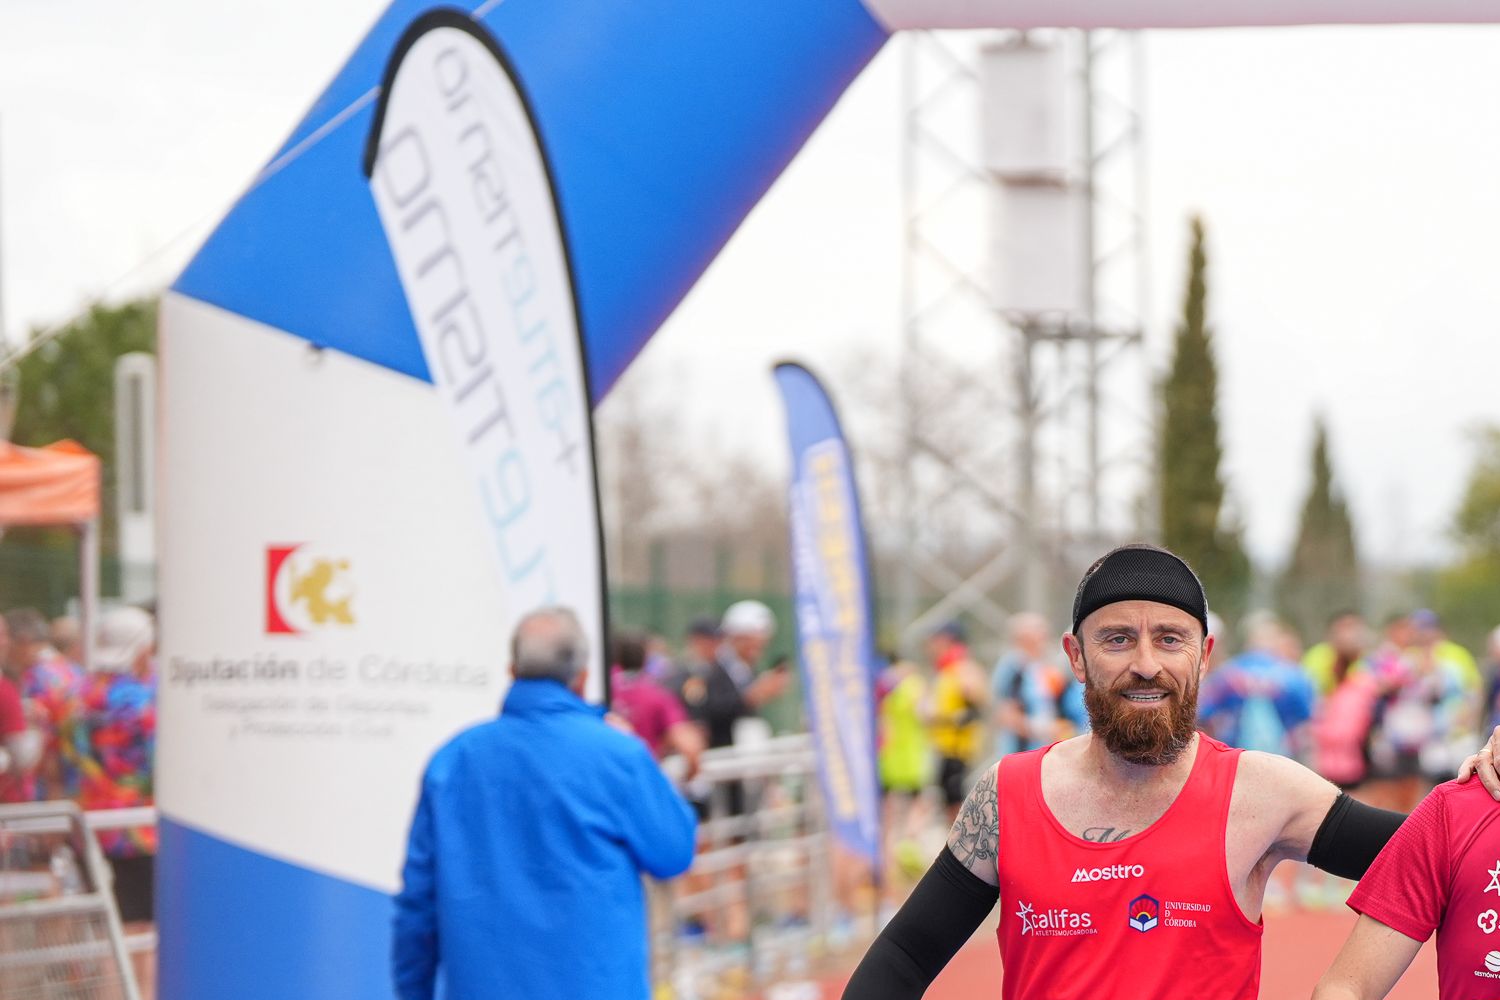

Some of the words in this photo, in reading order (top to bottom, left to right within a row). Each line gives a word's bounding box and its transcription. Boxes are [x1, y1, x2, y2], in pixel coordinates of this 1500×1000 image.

[307, 654, 346, 681] de
[1165, 901, 1211, 913] UNIVERSIDAD
[1031, 908, 1092, 929] califas
[1164, 917, 1197, 928] CÓRDOBA
